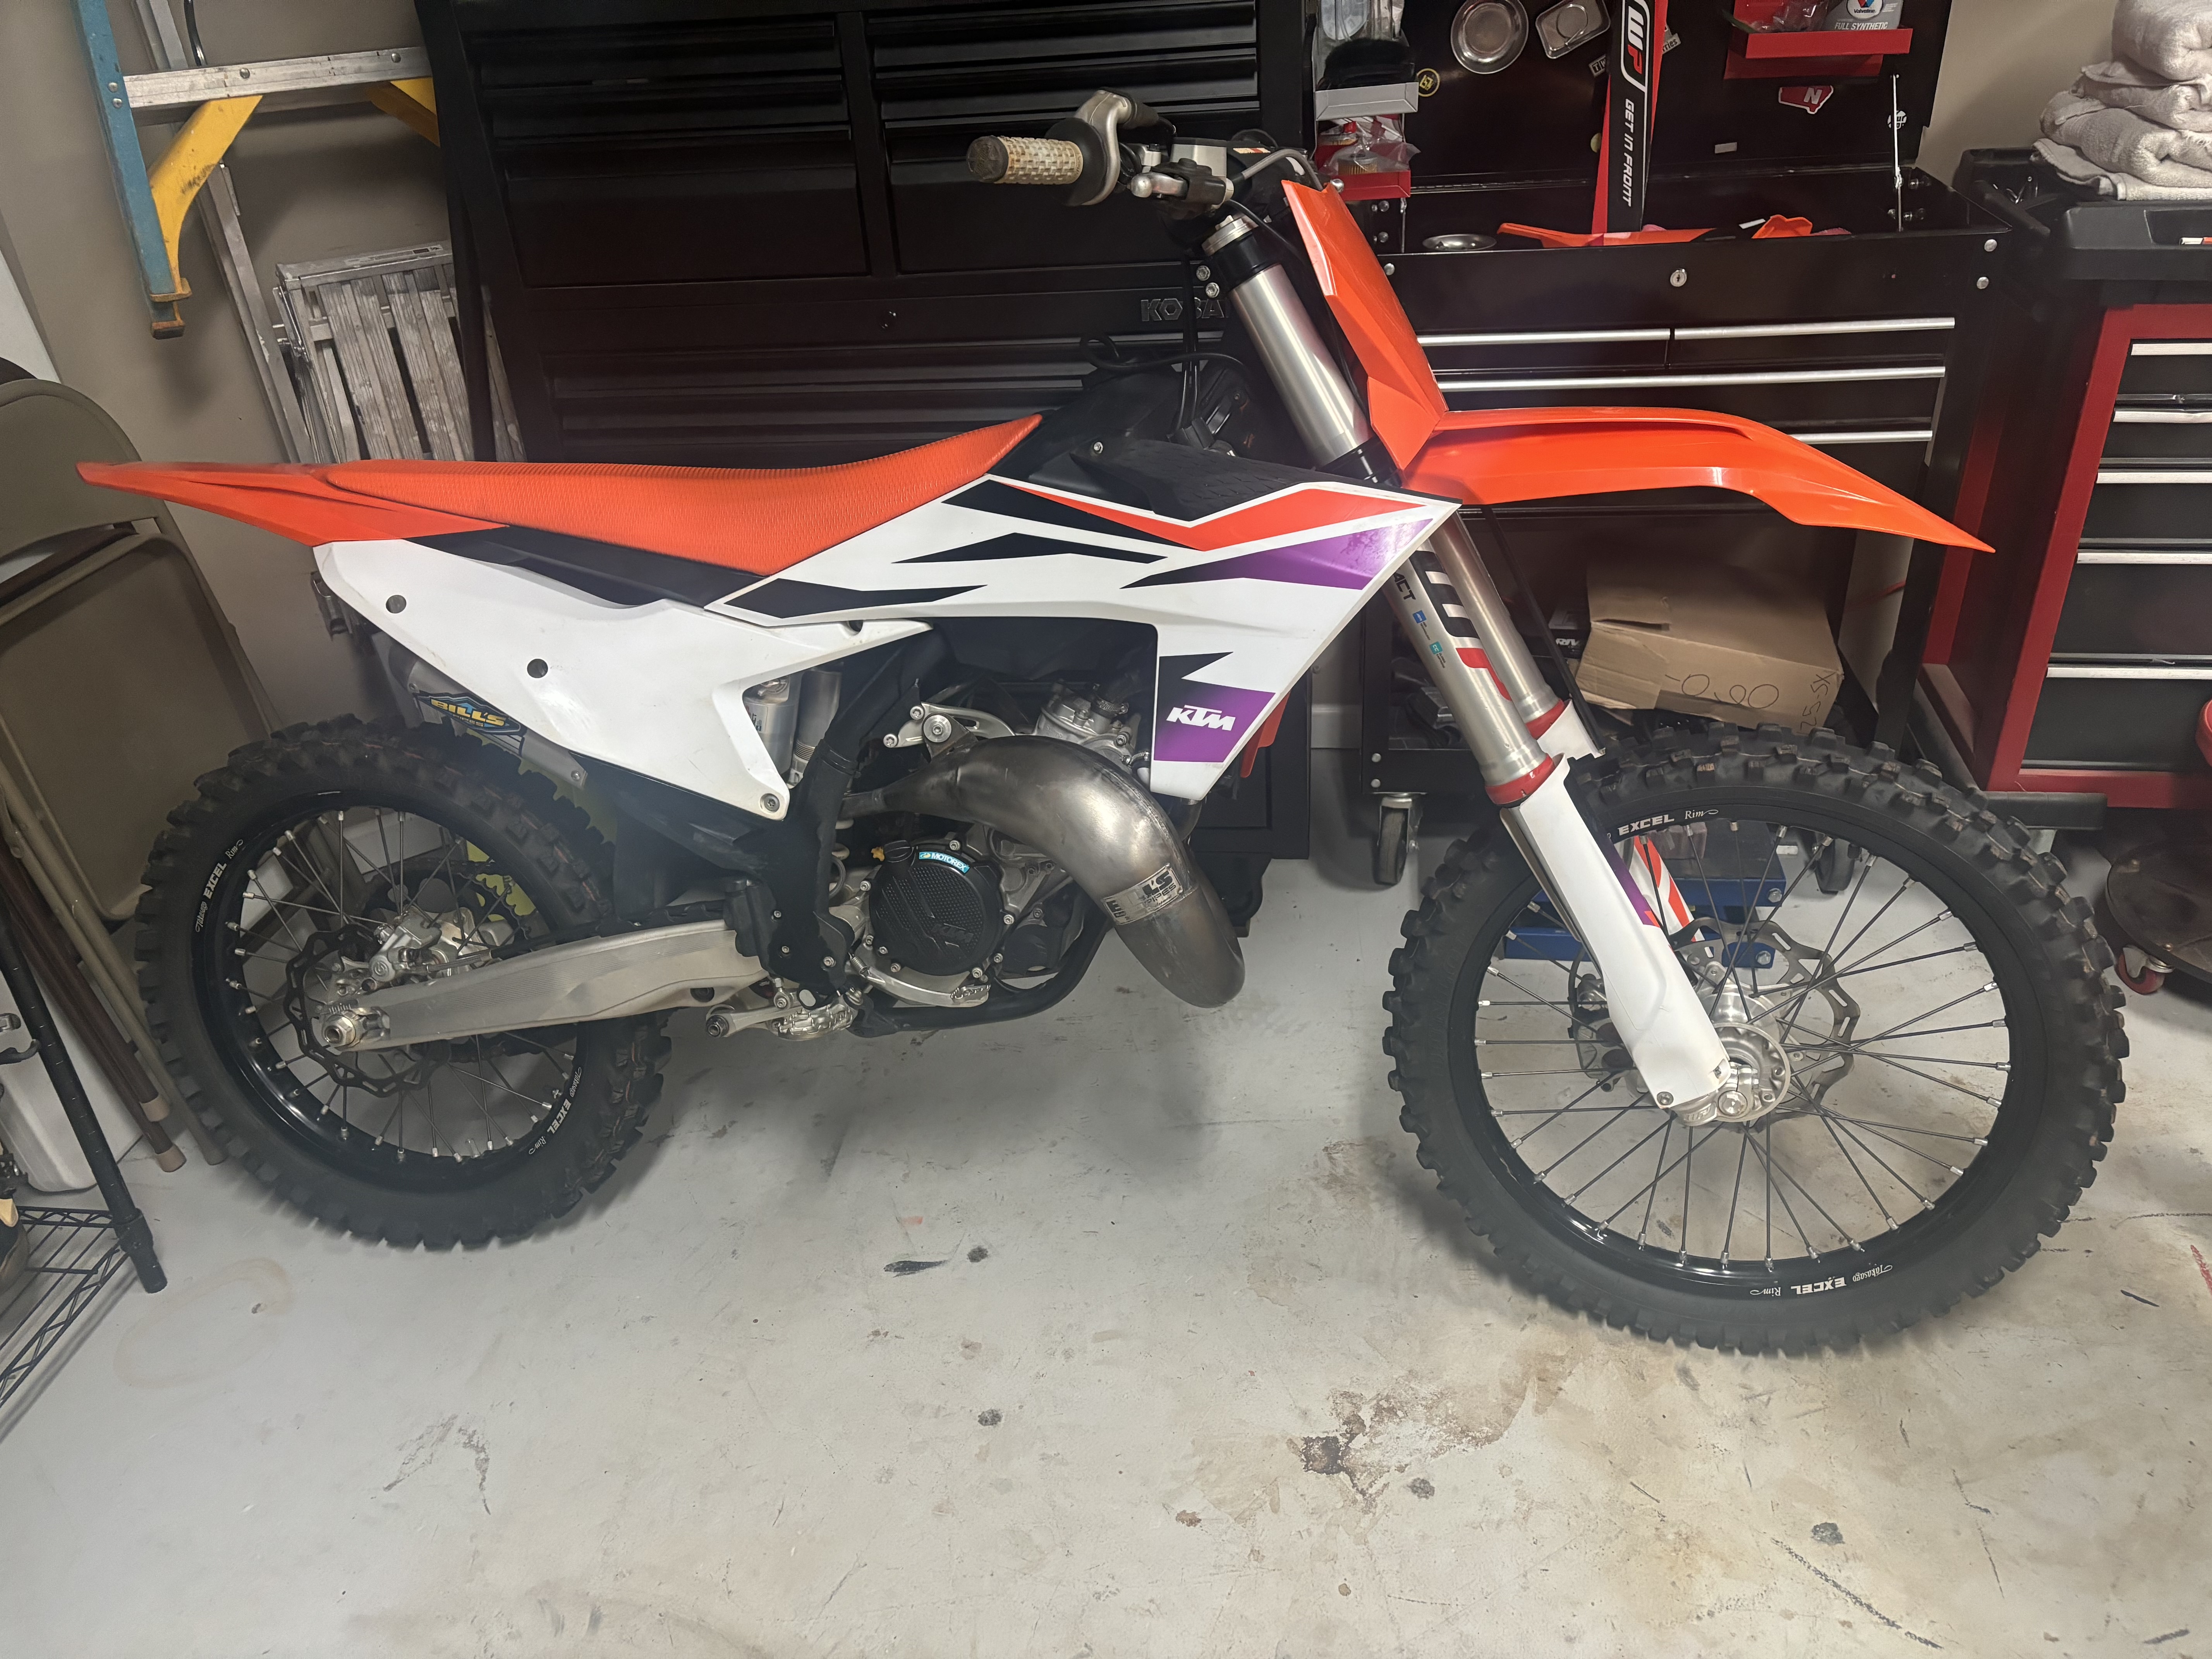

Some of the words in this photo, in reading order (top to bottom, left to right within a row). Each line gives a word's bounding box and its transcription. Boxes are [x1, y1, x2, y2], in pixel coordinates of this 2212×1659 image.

[1850, 22, 1888, 30] SYNTHETIC
[1628, 6, 1644, 74] WP
[1803, 87, 1822, 105] N
[1625, 98, 1634, 133] GET
[1622, 152, 1633, 207] FRONT
[431, 699, 507, 726] BILL'S
[1166, 704, 1236, 731] KTM
[1617, 814, 1675, 836] EXCEL
[1685, 809, 1719, 820] Rim
[203, 862, 227, 900] EXCEL
[225, 839, 244, 859] Rim
[931, 853, 967, 871] MOTOREX
[546, 1098, 572, 1134] EXCEL
[529, 1136, 547, 1154] Rim
[1790, 1277, 1847, 1295] EXCEL
[1852, 1264, 1893, 1282] Takasago
[1750, 1286, 1781, 1297] Rim
